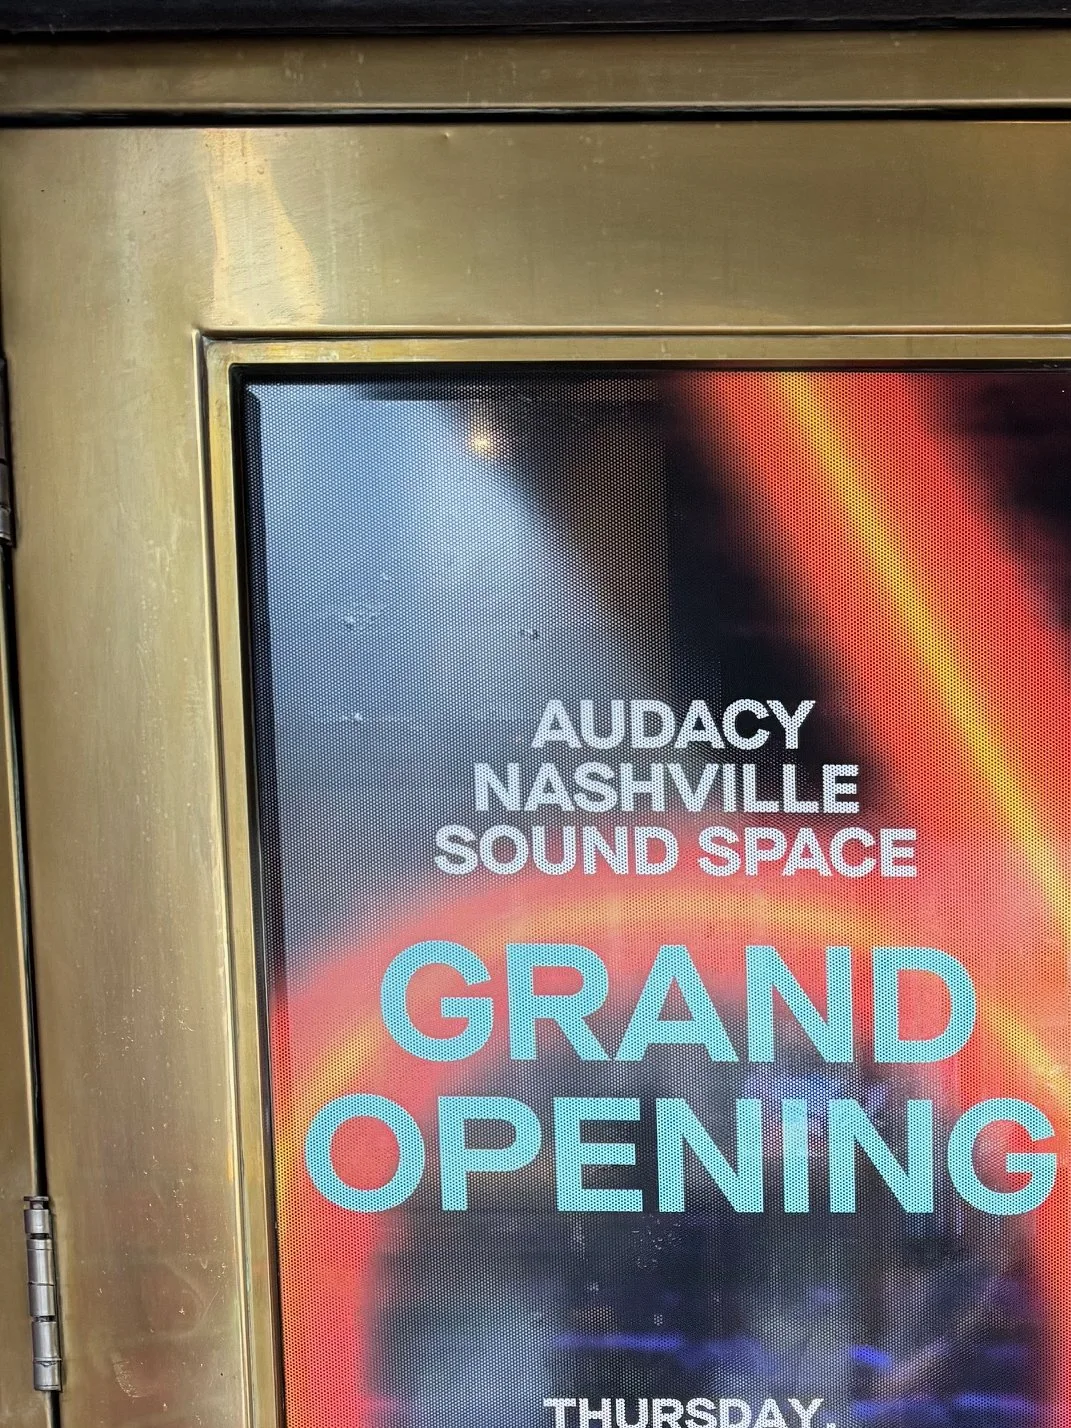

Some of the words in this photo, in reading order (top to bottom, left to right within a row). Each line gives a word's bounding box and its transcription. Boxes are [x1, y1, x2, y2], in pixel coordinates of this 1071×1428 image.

[531, 699, 816, 751] AUDACY
[474, 763, 860, 815] NASHVILLE
[433, 826, 679, 876] SOUND
[698, 826, 917, 877] SPACE
[380, 940, 978, 1064] GRAND
[304, 1093, 1059, 1216] OPENING
